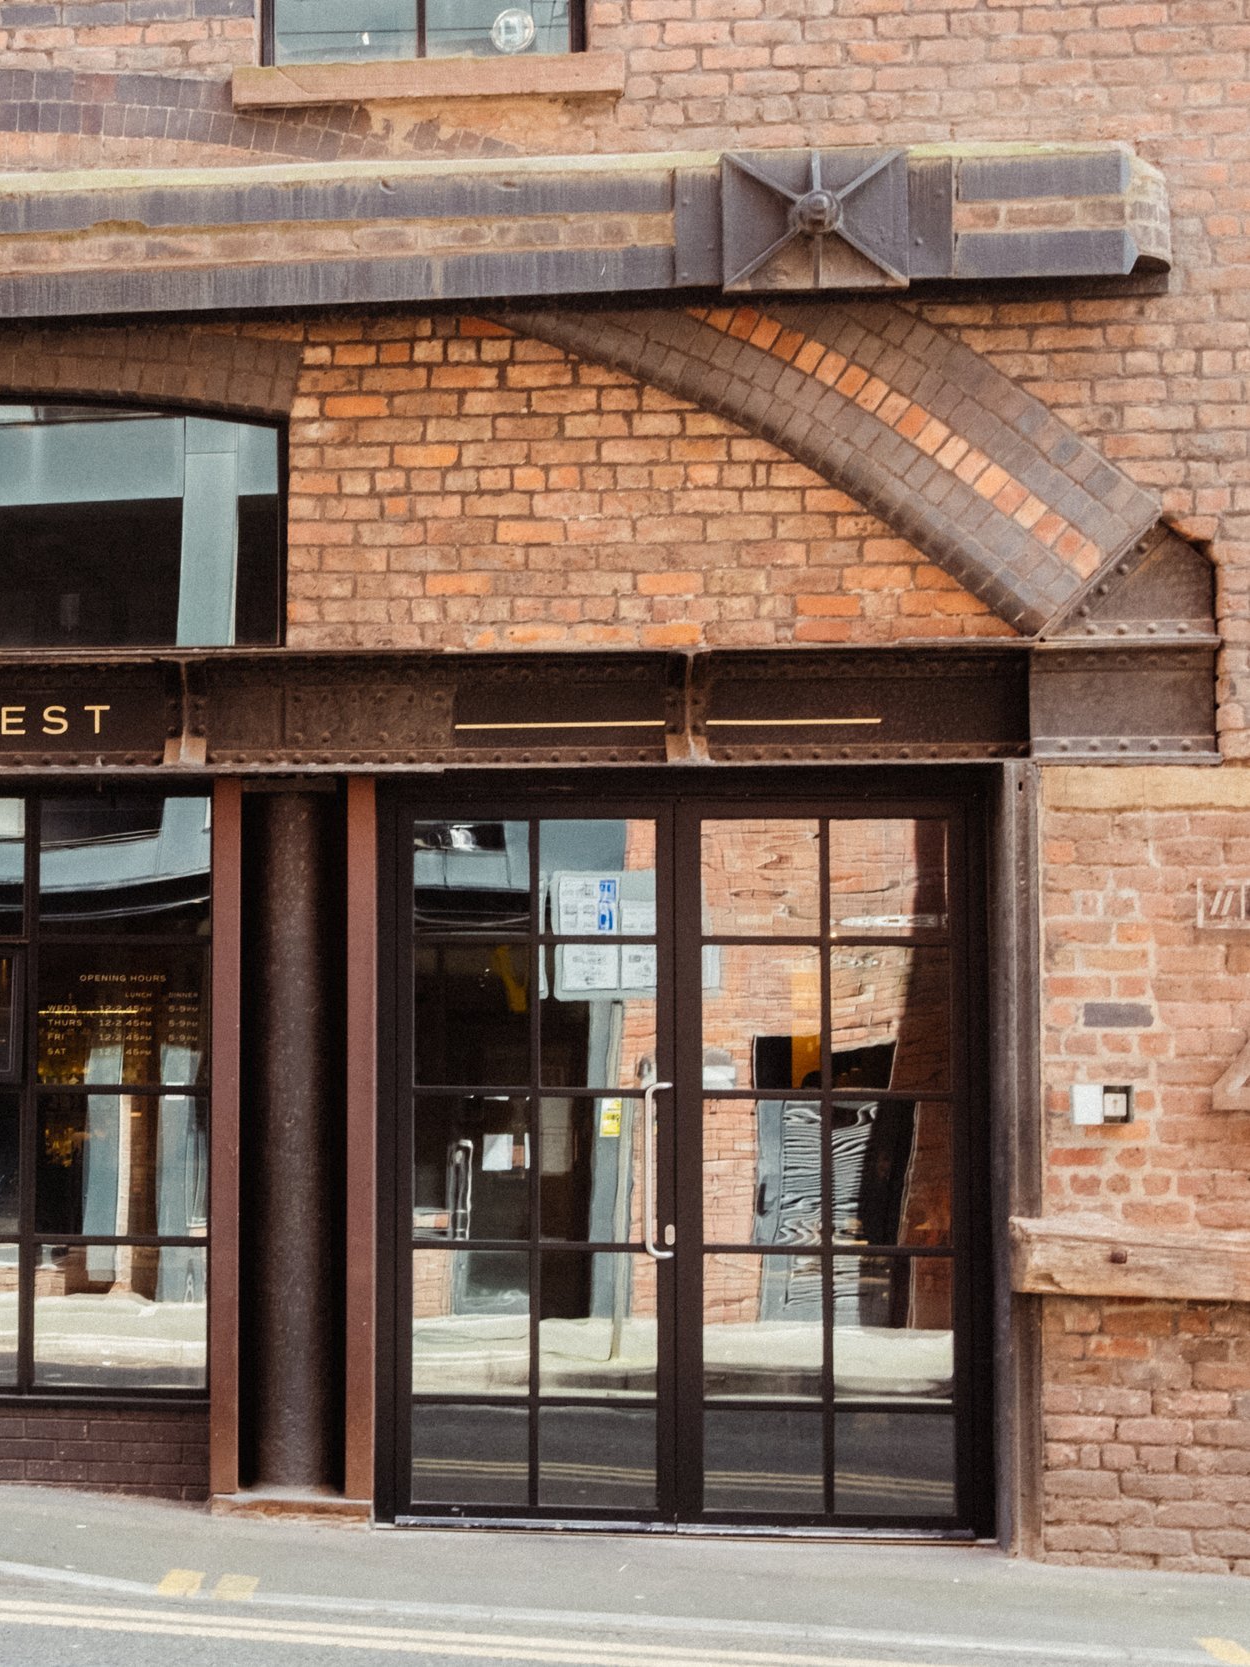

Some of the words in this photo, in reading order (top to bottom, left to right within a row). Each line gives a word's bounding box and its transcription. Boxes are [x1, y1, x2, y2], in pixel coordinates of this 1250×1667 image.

[79, 974, 127, 982] OPENING
[130, 974, 167, 982] HOURS
[47, 1004, 78, 1012] WEDS
[47, 1019, 83, 1027] THURS
[47, 1033, 65, 1041] FRI
[47, 1047, 67, 1055] SAT
